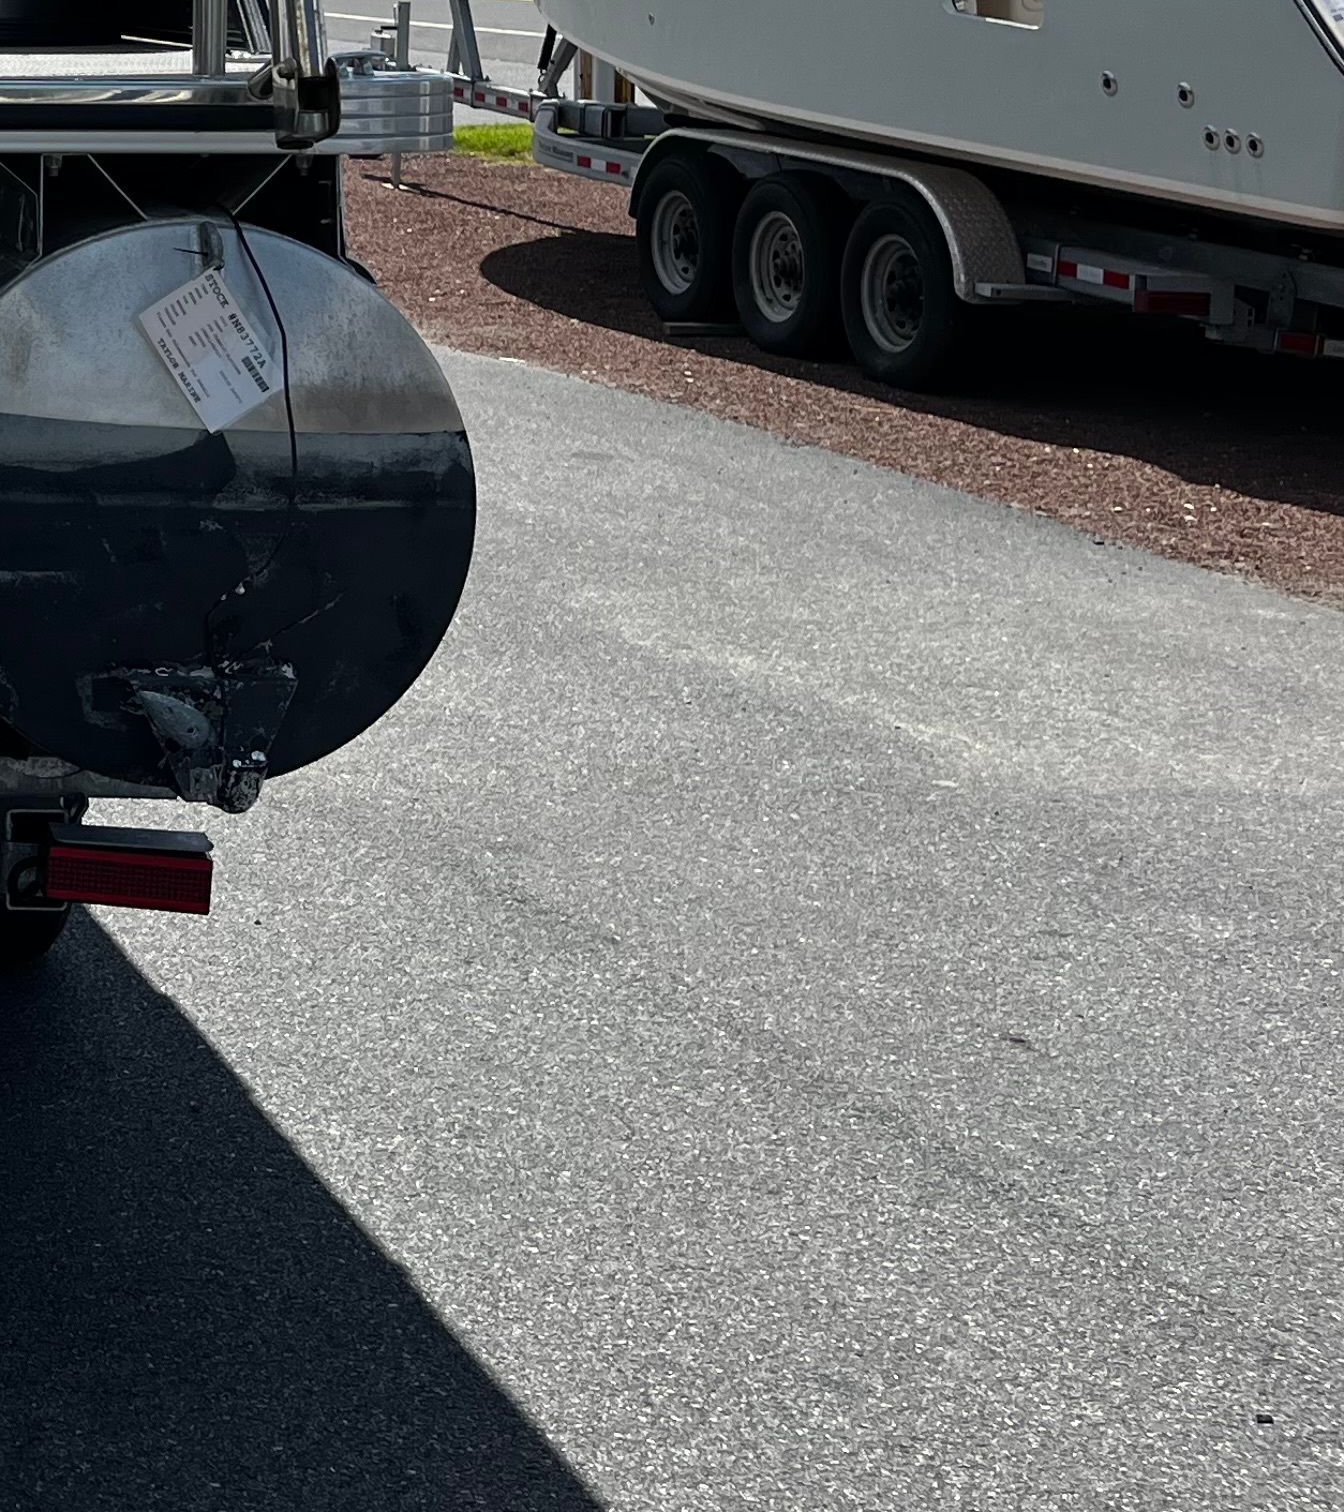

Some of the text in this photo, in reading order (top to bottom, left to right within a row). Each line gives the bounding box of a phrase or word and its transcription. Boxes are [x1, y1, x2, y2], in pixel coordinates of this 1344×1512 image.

[205, 274, 229, 308] STOCK
[157, 337, 180, 369] TAYLOR
[178, 371, 201, 403] MARINE
